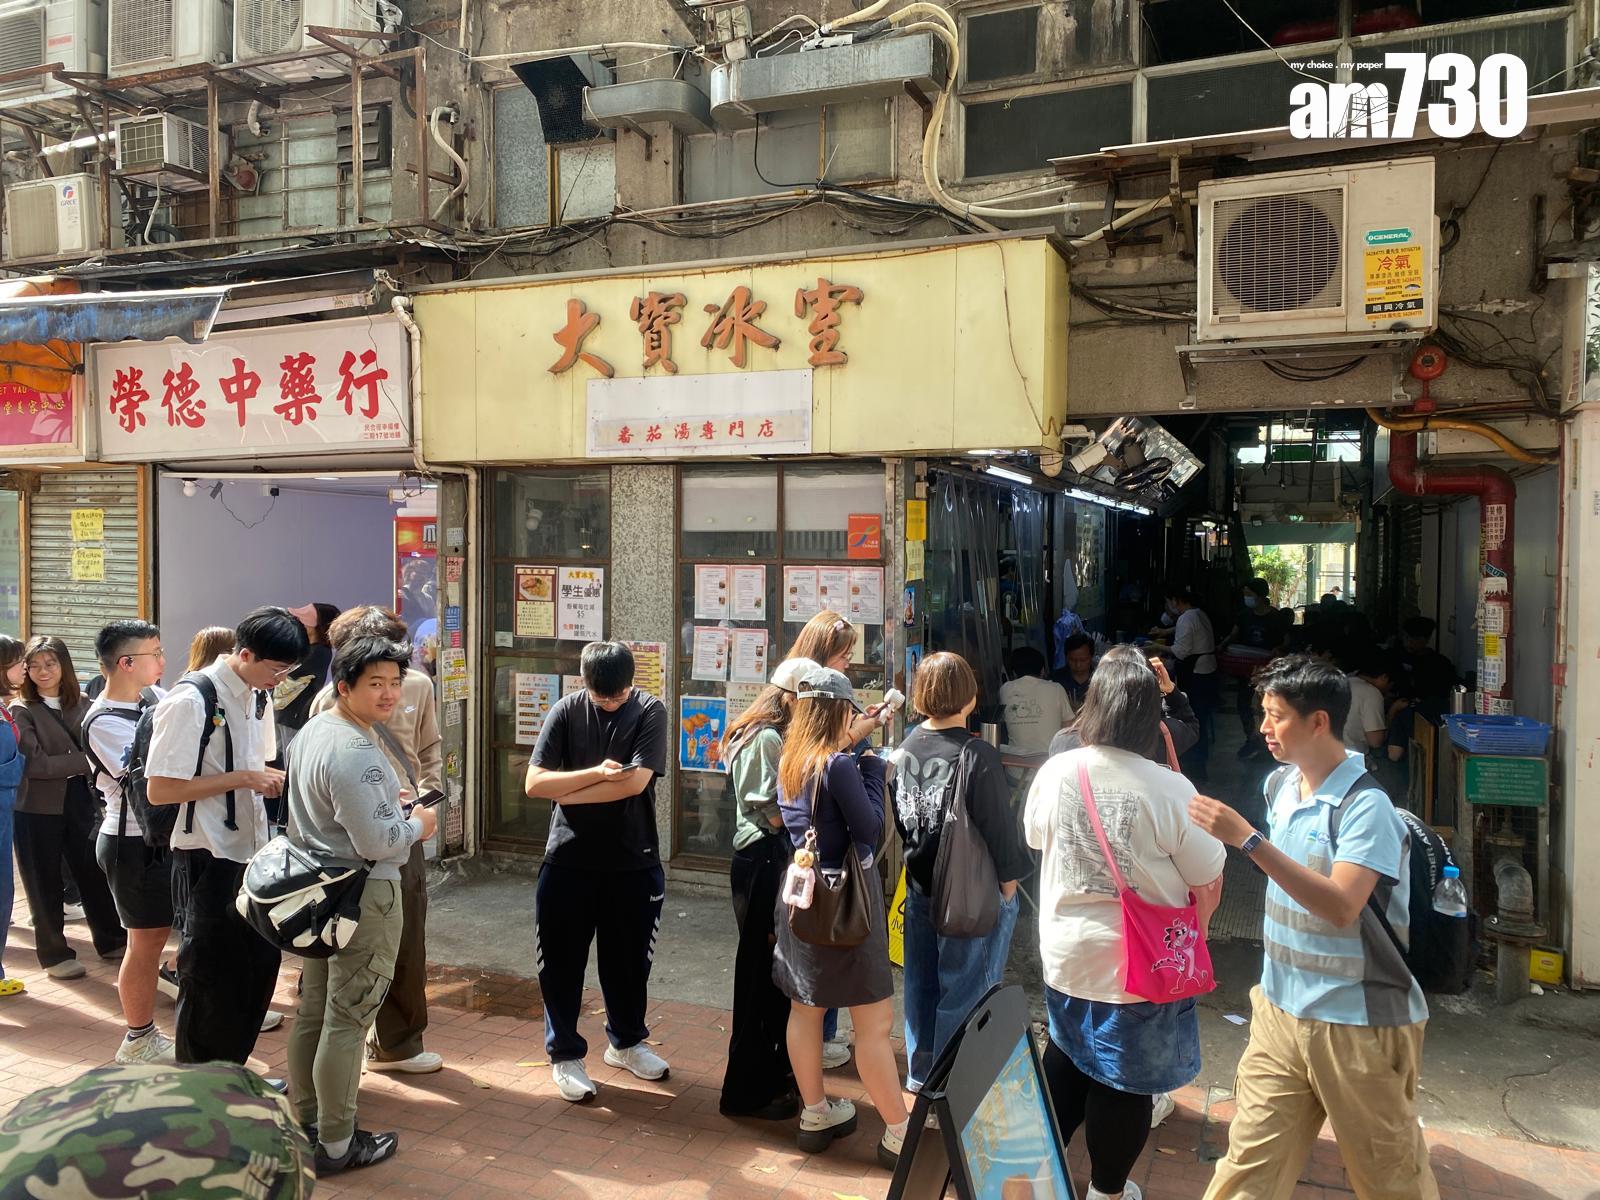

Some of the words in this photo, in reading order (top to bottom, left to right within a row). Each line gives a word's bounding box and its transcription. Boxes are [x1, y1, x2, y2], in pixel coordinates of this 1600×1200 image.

[1377, 255, 1411, 271] 冷氣
[548, 278, 864, 378] 大寶冰室
[109, 349, 388, 433] 榮德中藥行
[617, 420, 775, 444] 番茄湯專門店
